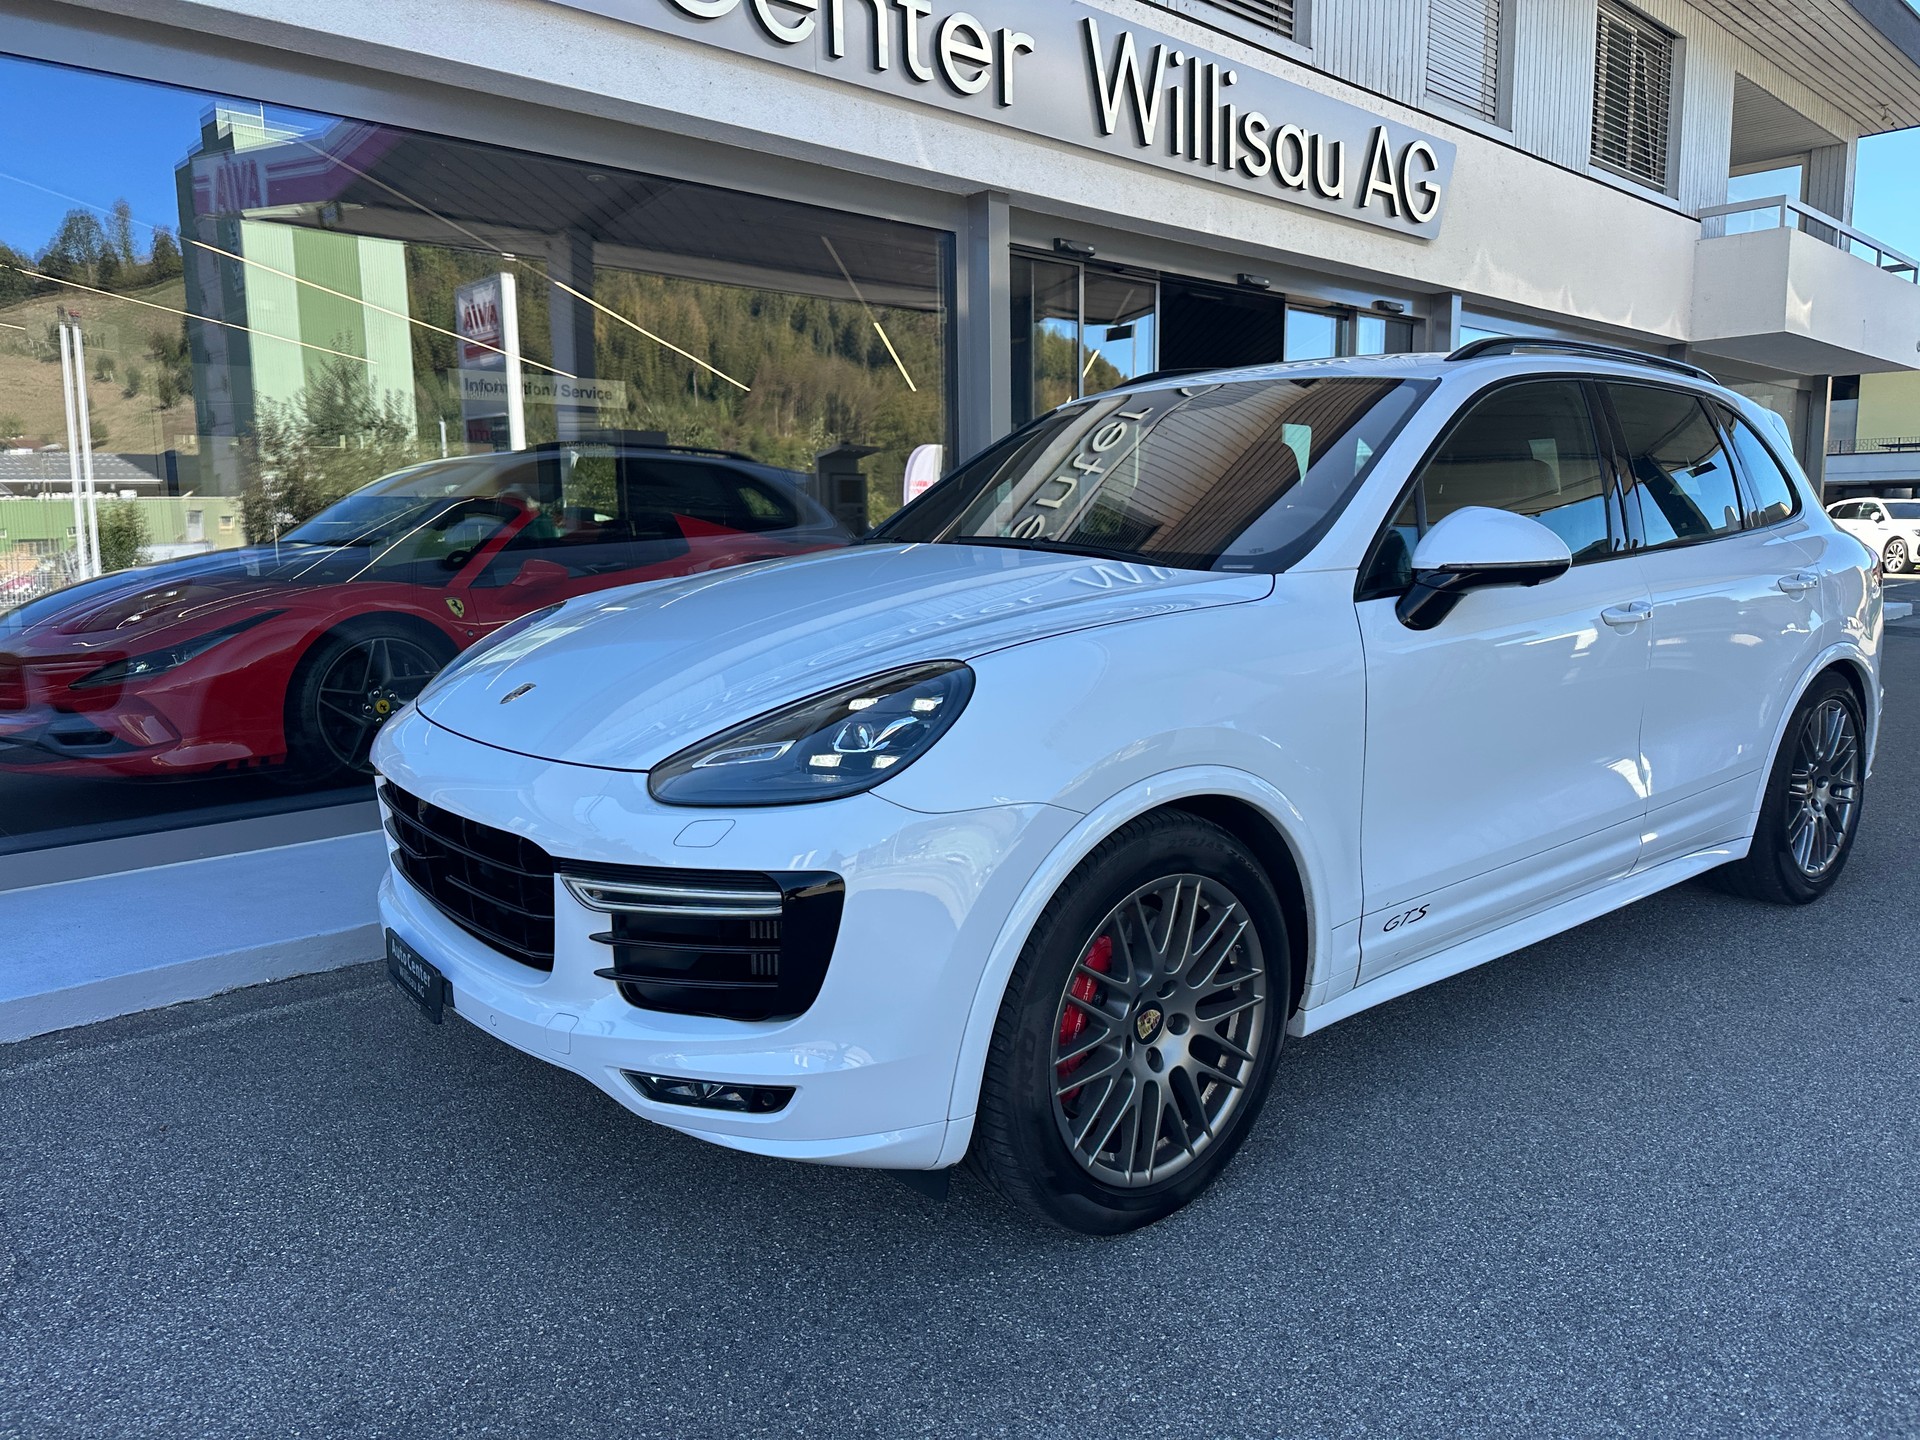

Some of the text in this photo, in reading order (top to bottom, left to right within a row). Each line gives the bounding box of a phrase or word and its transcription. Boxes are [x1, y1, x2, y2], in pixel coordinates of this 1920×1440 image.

[663, 0, 1442, 225] enter Willisau AG
[464, 378, 550, 396] Infortion
[561, 384, 613, 401] Service
[1383, 903, 1431, 932] GTS
